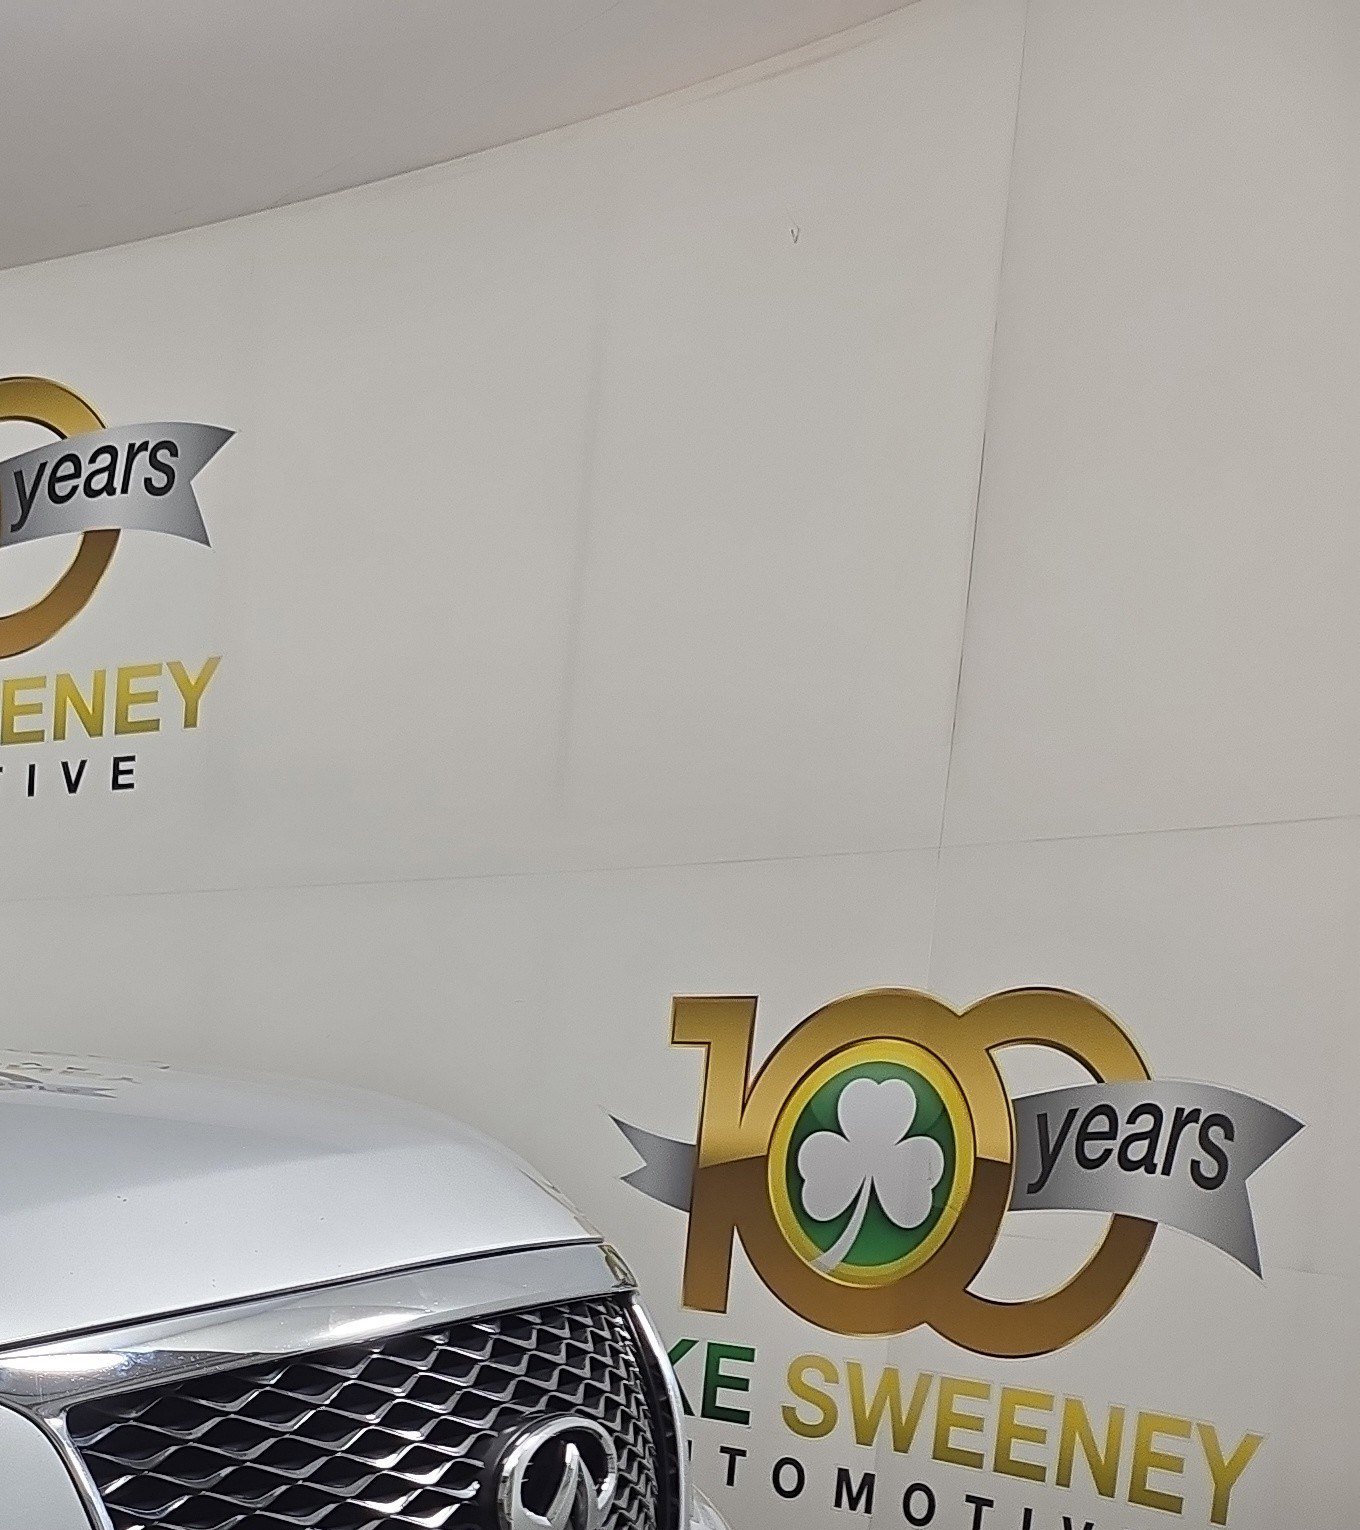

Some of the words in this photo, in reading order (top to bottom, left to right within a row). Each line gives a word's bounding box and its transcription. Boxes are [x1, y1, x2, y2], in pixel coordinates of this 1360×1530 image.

[9, 438, 179, 533] years
[1026, 1102, 1235, 1194] years
[781, 1354, 1264, 1527] SWEENEY
